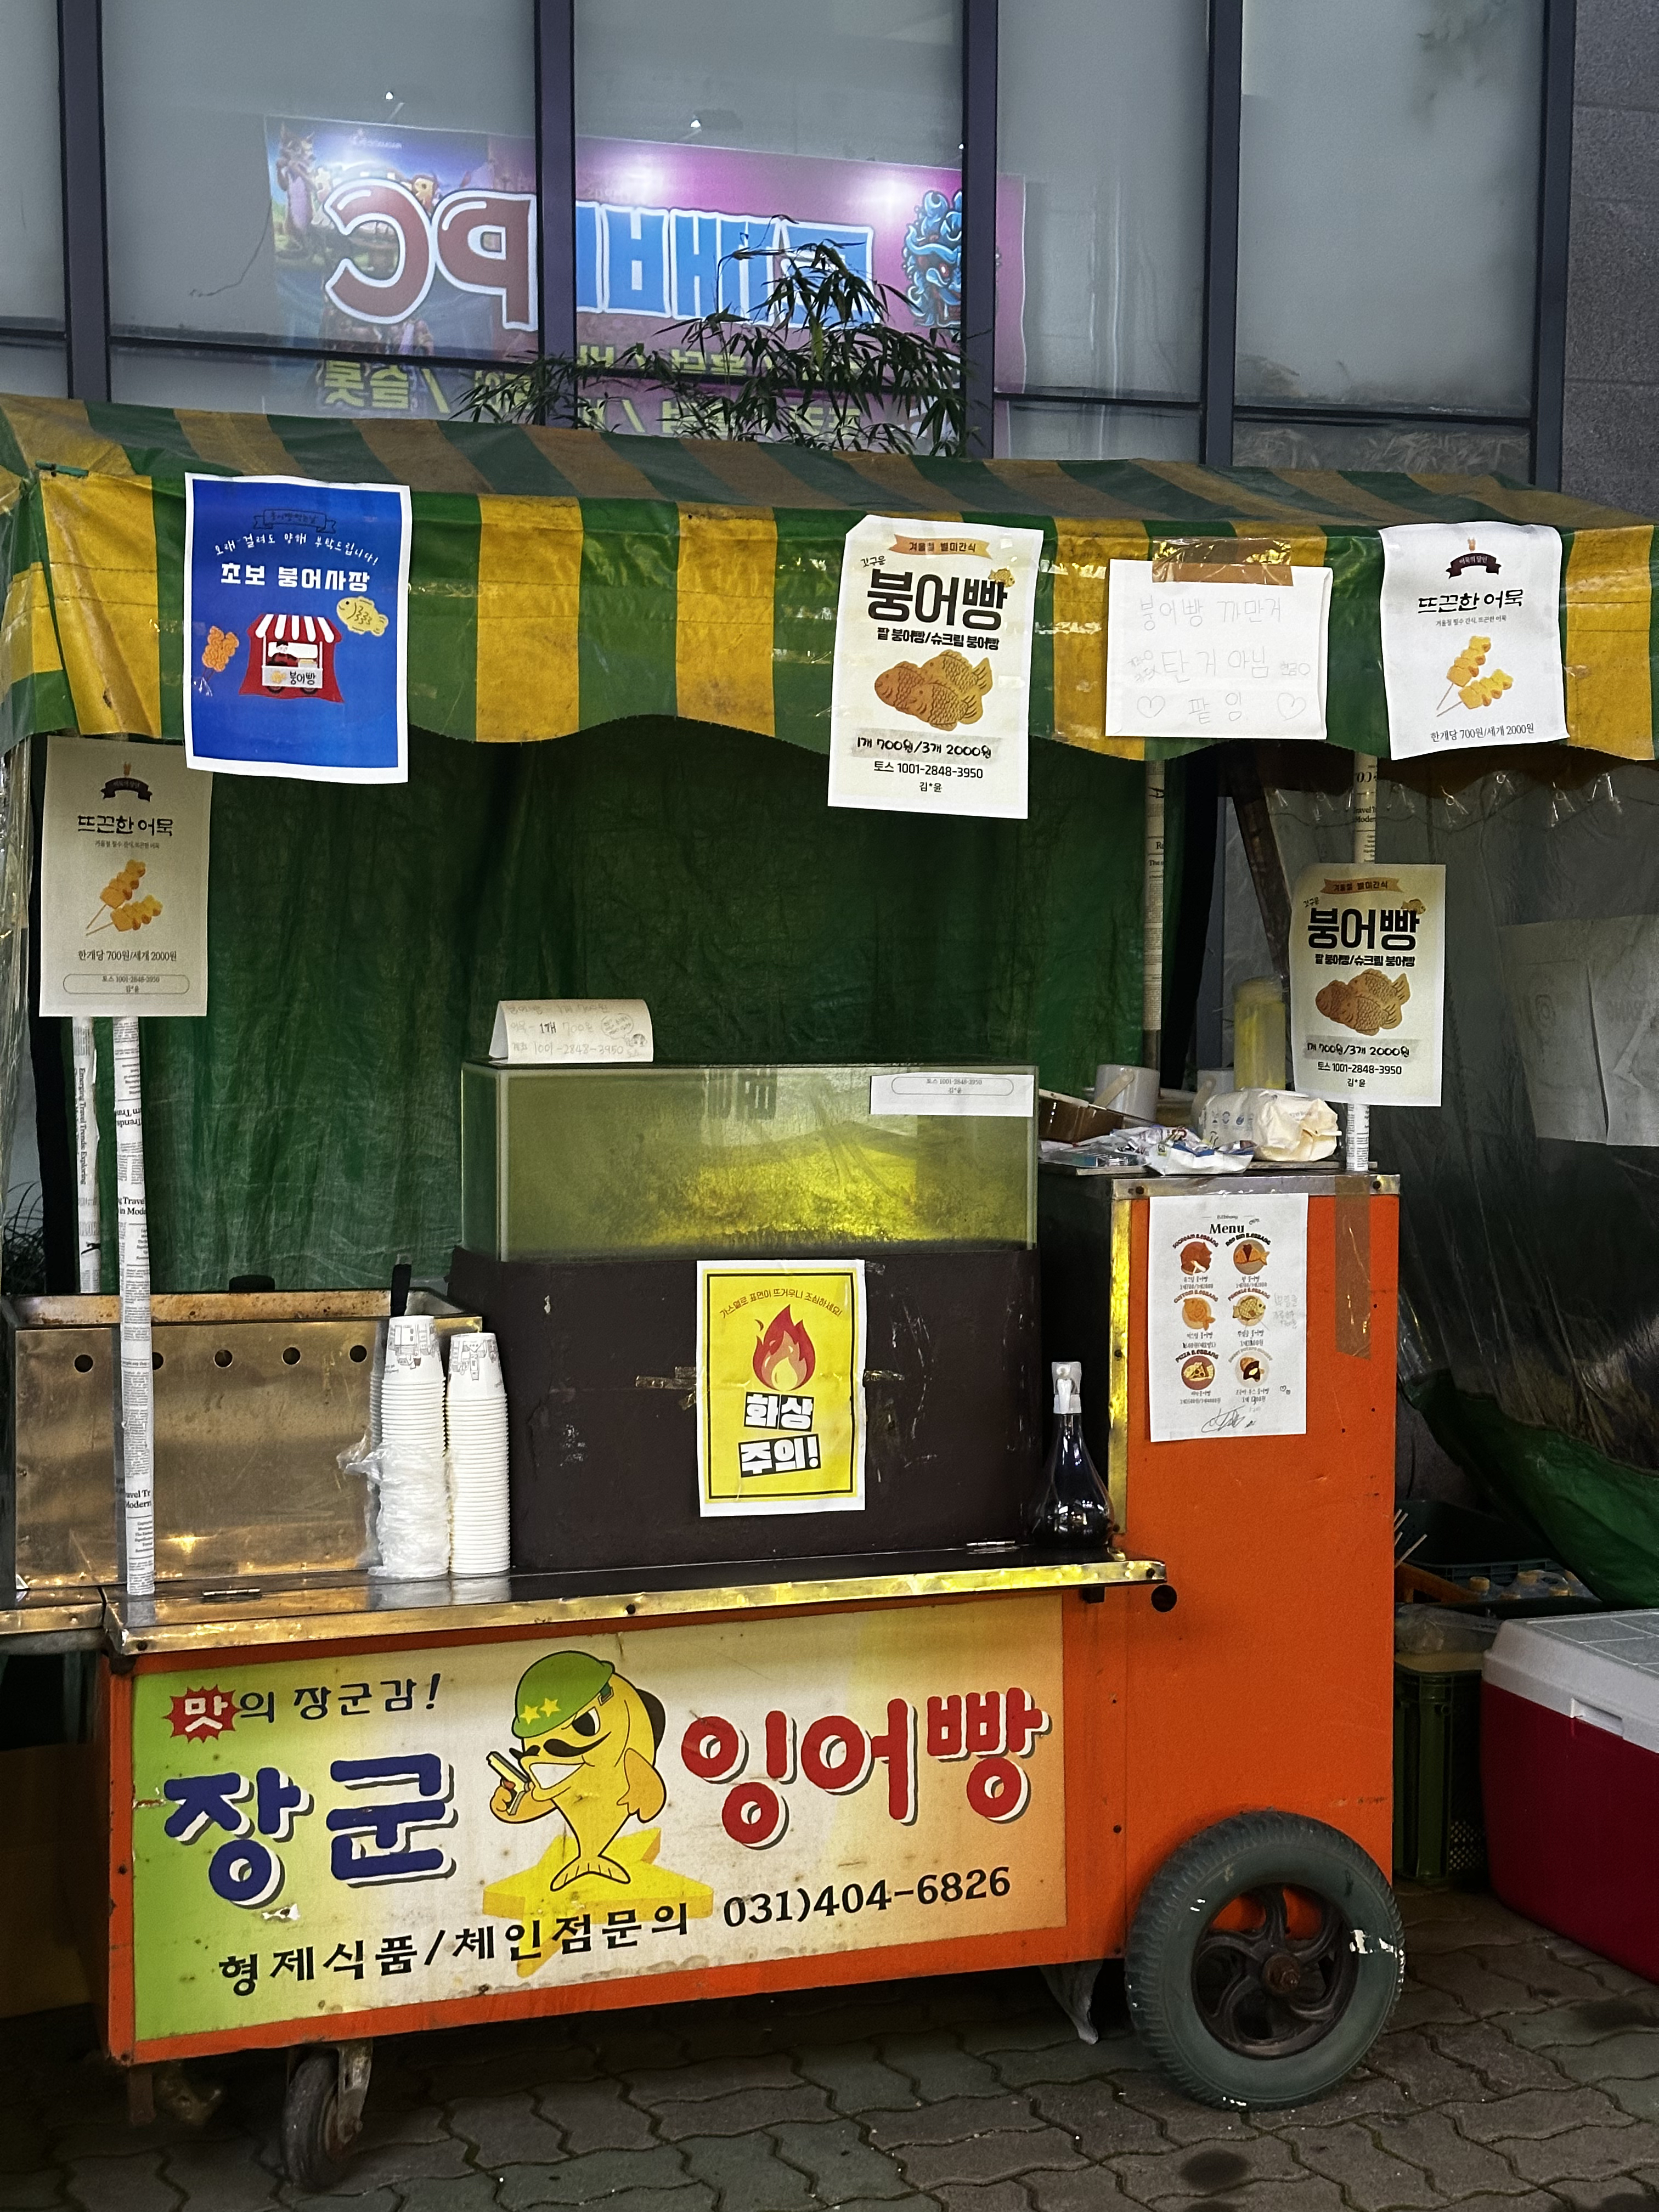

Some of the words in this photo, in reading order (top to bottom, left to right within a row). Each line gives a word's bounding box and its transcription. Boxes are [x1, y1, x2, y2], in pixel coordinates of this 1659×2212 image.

[215, 539, 236, 556] 오래
[243, 533, 276, 549] 걸려도
[940, 541, 977, 553] 별미간식
[221, 562, 266, 586] 초보
[278, 566, 370, 592] 붕어사장
[867, 568, 1008, 630] 붕어빵
[1417, 592, 1480, 614] 뜨끈한
[1483, 589, 1523, 610] 어묵
[1140, 595, 1203, 631] 붕어빵
[877, 627, 889, 641] 팥
[891, 628, 964, 648] 붕어빵/슈크림
[966, 635, 1000, 651] 붕어빵
[1161, 649, 1190, 684] 탄
[1228, 646, 1269, 679] 아님
[289, 670, 317, 686] 붕어빵
[1188, 697, 1211, 725] 팥
[1224, 692, 1242, 722] 임
[1430, 730, 1458, 743] 한개당
[1459, 726, 1505, 741] 700원/세개
[1506, 723, 1534, 736] 2000원
[857, 736, 873, 749] 1개
[876, 738, 943, 755] 700원/3개
[946, 743, 992, 759] 2000원
[873, 760, 895, 773] 토스
[897, 762, 984, 779] 1001-2848-3950
[77, 814, 134, 834] 뜨끈한
[137, 817, 173, 836] 어묵
[1357, 881, 1388, 890] 별미간식
[1307, 907, 1420, 951] 붕어빵
[78, 950, 105, 961] 한개당
[106, 950, 149, 962] 700원/세개
[151, 951, 177, 962] 2000원
[1325, 954, 1384, 967] 붕어빵/슈크림
[1386, 955, 1415, 967] 붕어빵
[533, 1041, 624, 1056] 1001-2848-3950
[1318, 1042, 1366, 1056] 700원/3개
[1369, 1046, 1410, 1058] 2000원
[1317, 1061, 1331, 1071] 토스
[1332, 1062, 1402, 1075] 1001-2848-3950
[1209, 1223, 1245, 1234] Menu
[719, 1296, 749, 1319] 가스열로
[749, 1289, 772, 1303] 표면이
[773, 1288, 803, 1299] 뜨거우니
[804, 1291, 843, 1317] 조심하세요!
[745, 1392, 814, 1430] 화상
[741, 1436, 819, 1475] 주의!
[184, 1690, 275, 1734] 맛의
[294, 1673, 441, 1720] 장군감!
[164, 1753, 457, 1908] 장군
[681, 1686, 1052, 1850] 잉어빵
[218, 1901, 688, 1997] 형제식품/체인점문의
[723, 1866, 1012, 1928] 031)404-6826
